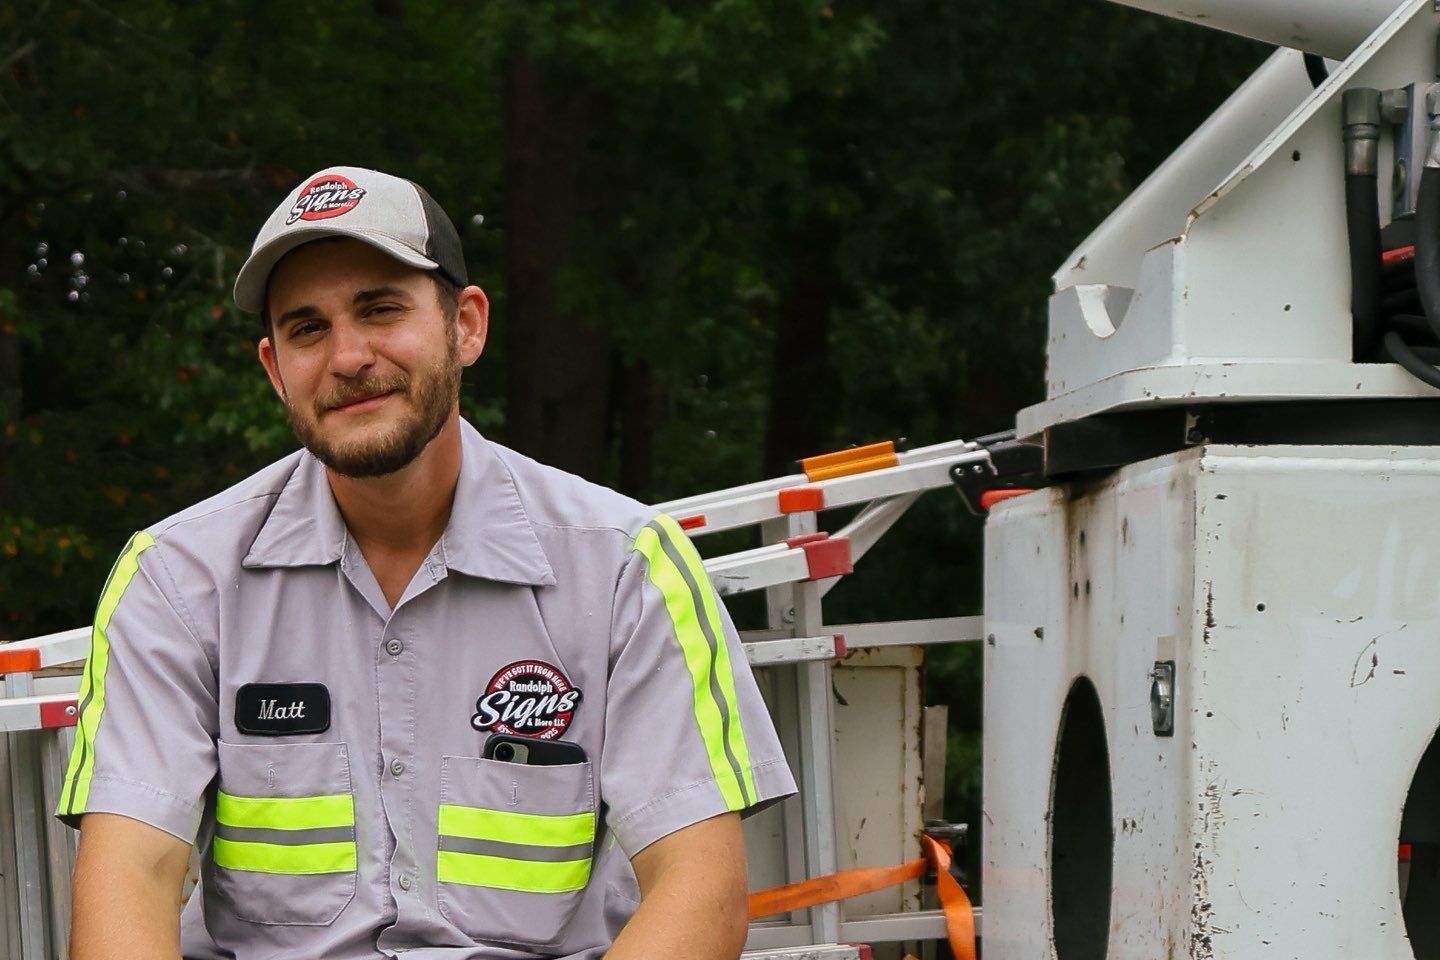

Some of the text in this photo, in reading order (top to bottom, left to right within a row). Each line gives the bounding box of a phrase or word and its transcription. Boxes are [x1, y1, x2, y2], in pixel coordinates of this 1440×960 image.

[310, 182, 347, 194] Randolph
[287, 188, 364, 224] Signs
[510, 681, 553, 695] Randolph
[512, 665, 525, 675] GOT
[526, 665, 534, 673] IT
[534, 666, 554, 679] FROM
[551, 673, 567, 692] HERE
[258, 699, 305, 719] Matt
[474, 690, 579, 728] Signs
[535, 719, 553, 727] More
[554, 719, 566, 727] LLC
